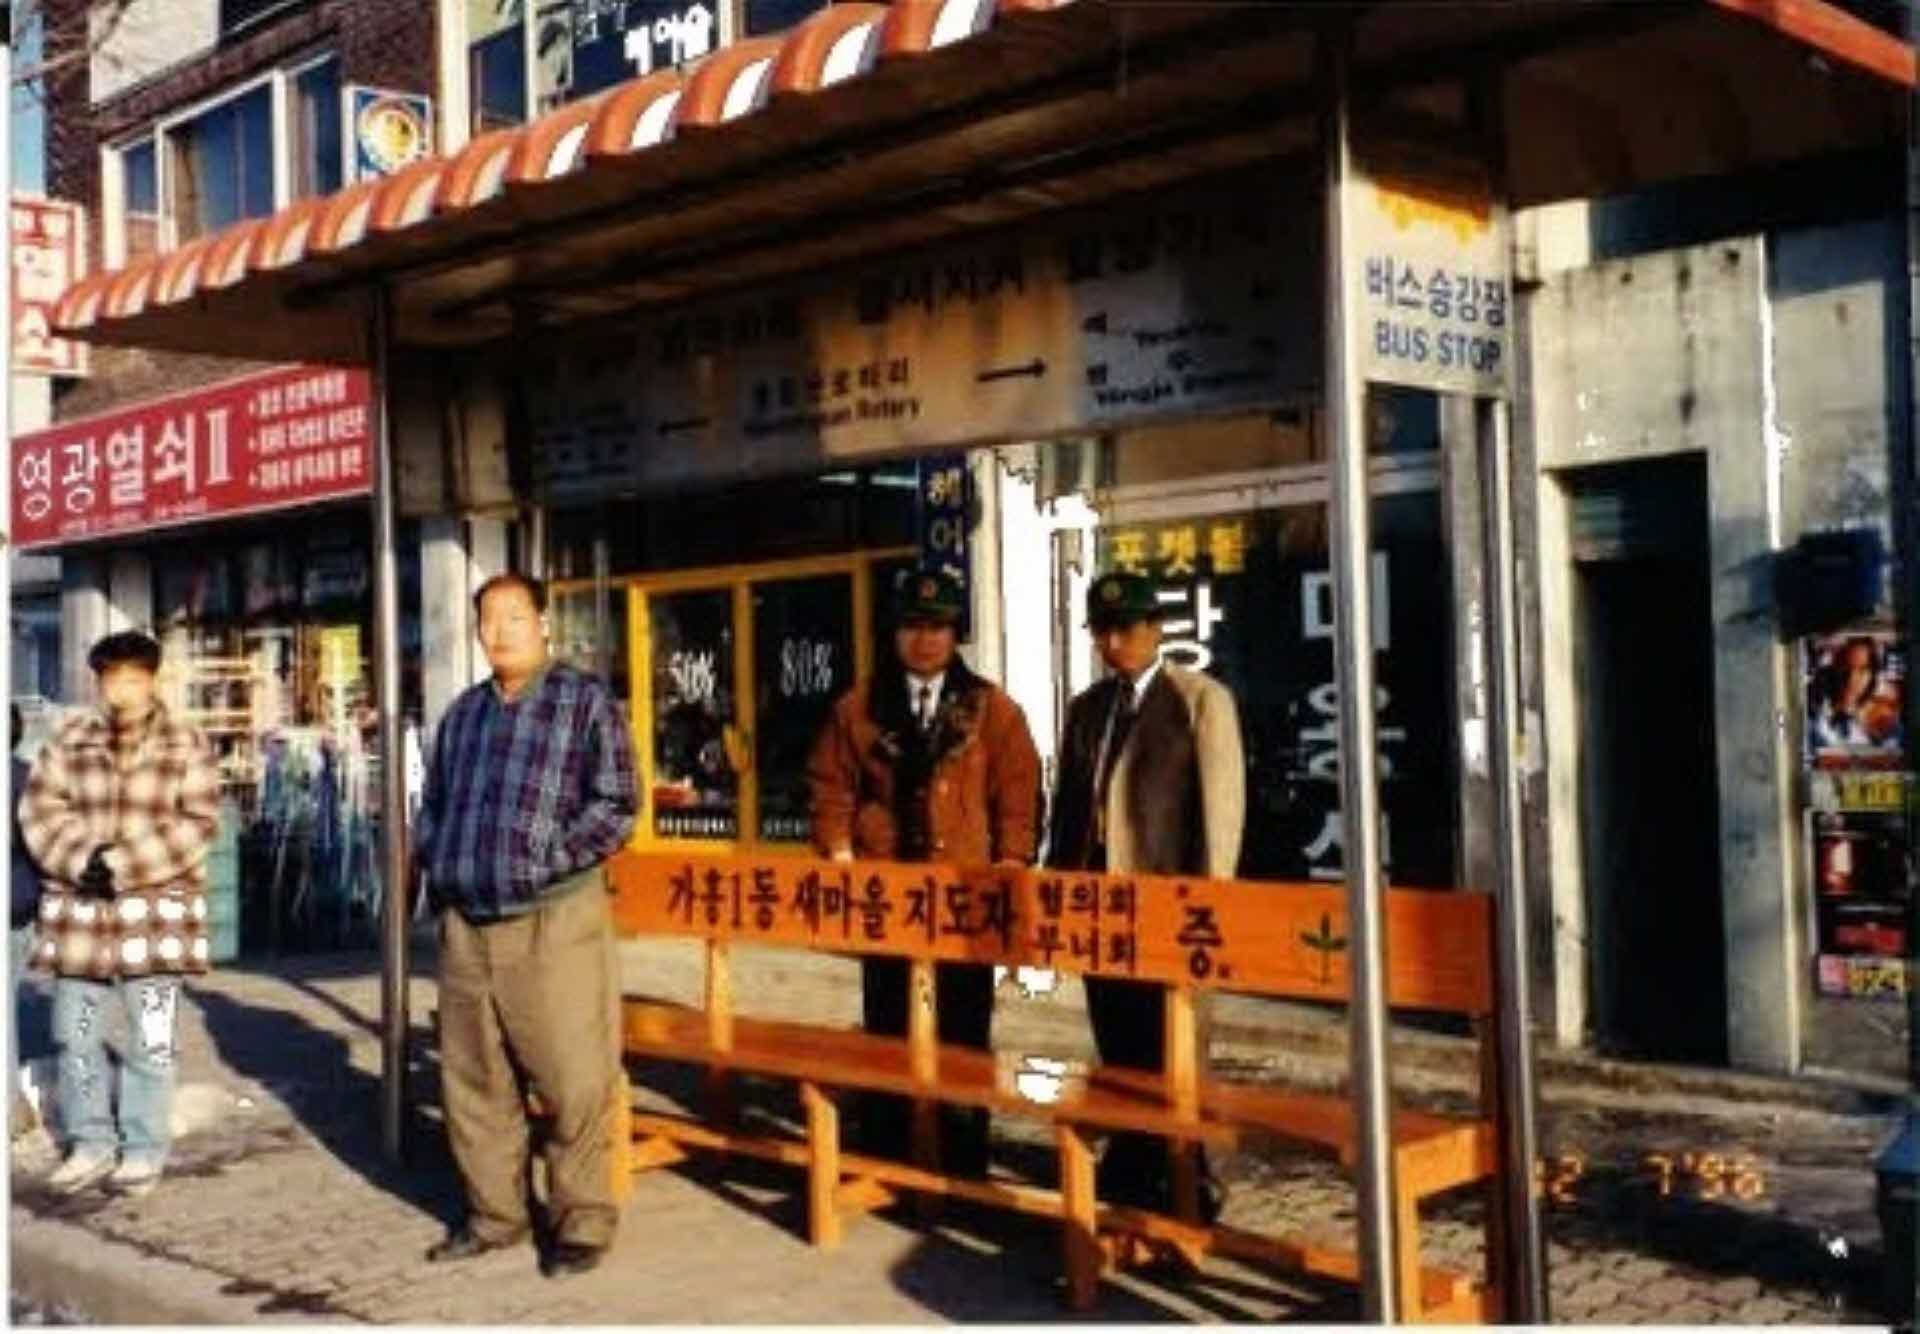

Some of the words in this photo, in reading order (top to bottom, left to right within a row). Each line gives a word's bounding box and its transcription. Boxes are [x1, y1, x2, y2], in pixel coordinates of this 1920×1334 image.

[1364, 256, 1506, 327] 버스승강장
[1376, 318, 1427, 362] BUS
[1438, 330, 1501, 373] STOP
[667, 863, 781, 931] 가흥1동
[788, 865, 893, 940] 새마을
[902, 873, 1019, 951] 지도자
